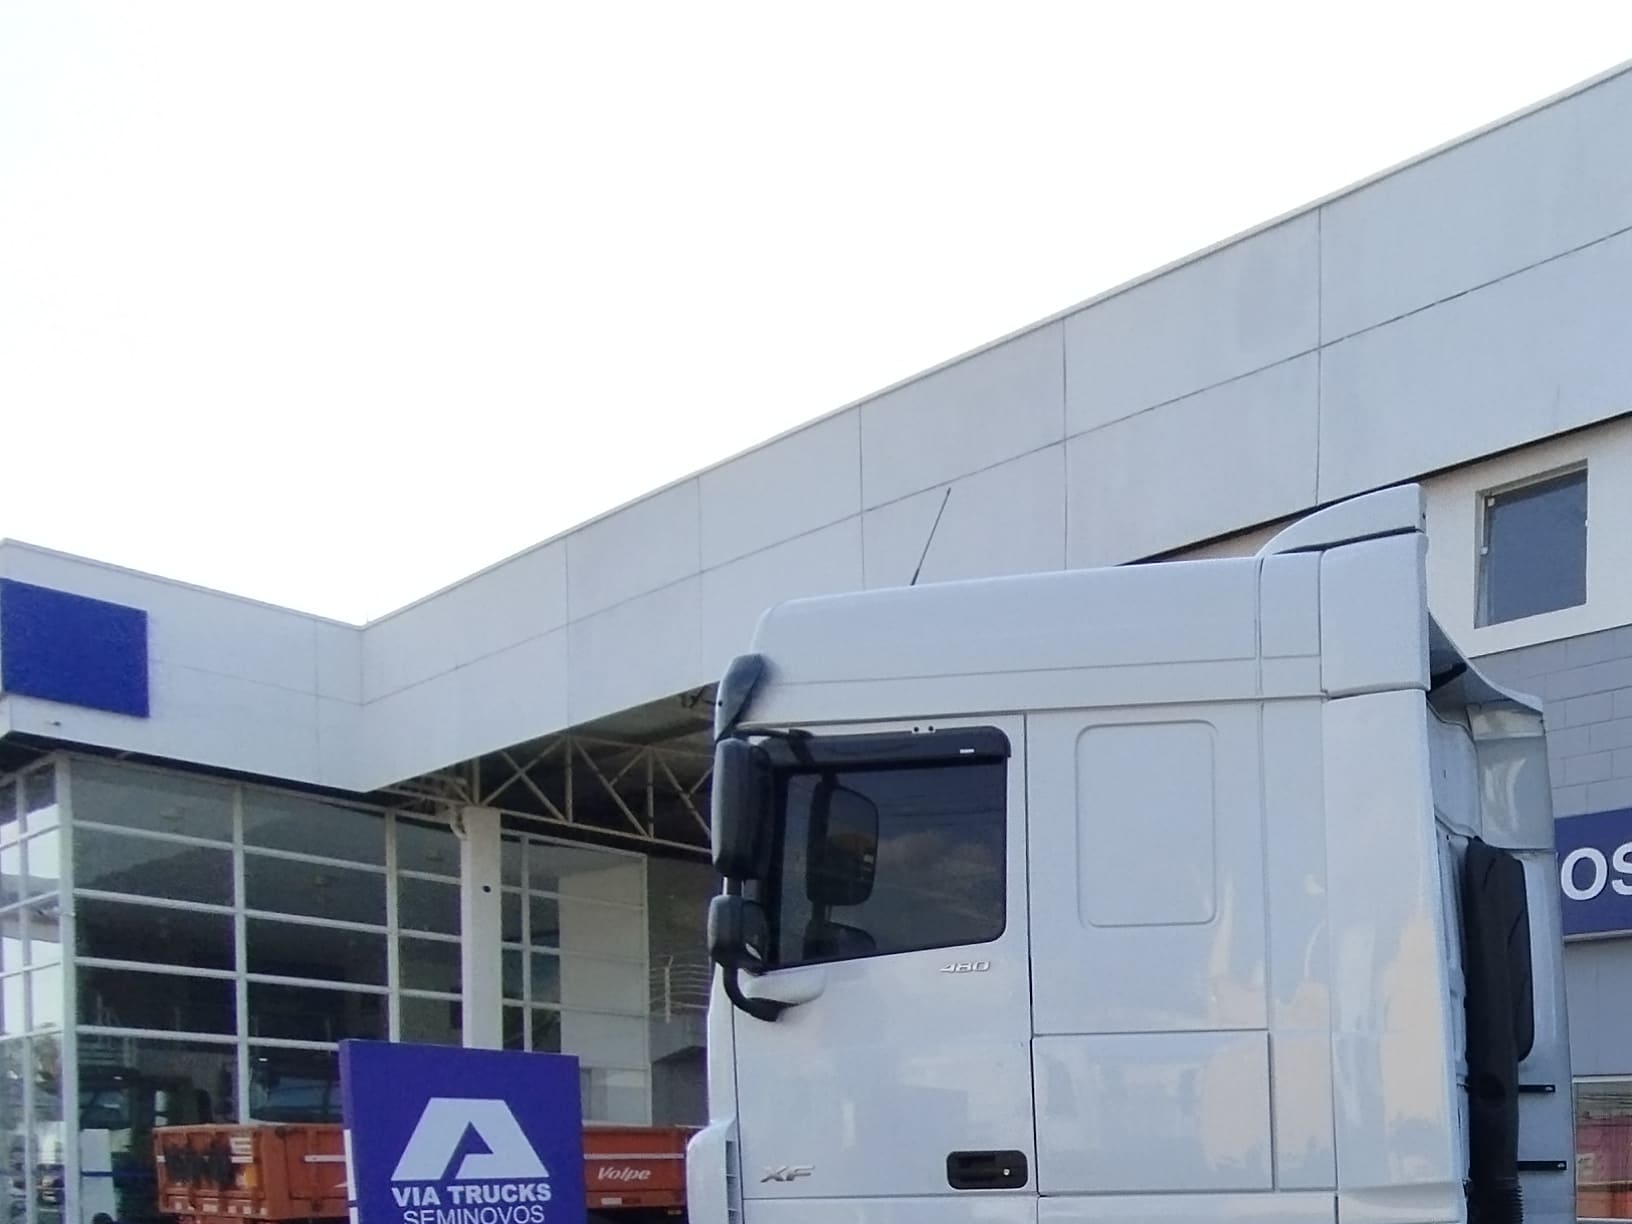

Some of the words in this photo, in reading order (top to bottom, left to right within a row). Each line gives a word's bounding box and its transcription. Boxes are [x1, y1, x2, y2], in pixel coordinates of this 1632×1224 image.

[940, 961, 991, 973] 480
[598, 1166, 651, 1181] Volpe
[761, 1165, 815, 1183] XF
[391, 1186, 440, 1208] VIA
[447, 1182, 552, 1205] TRUCKS
